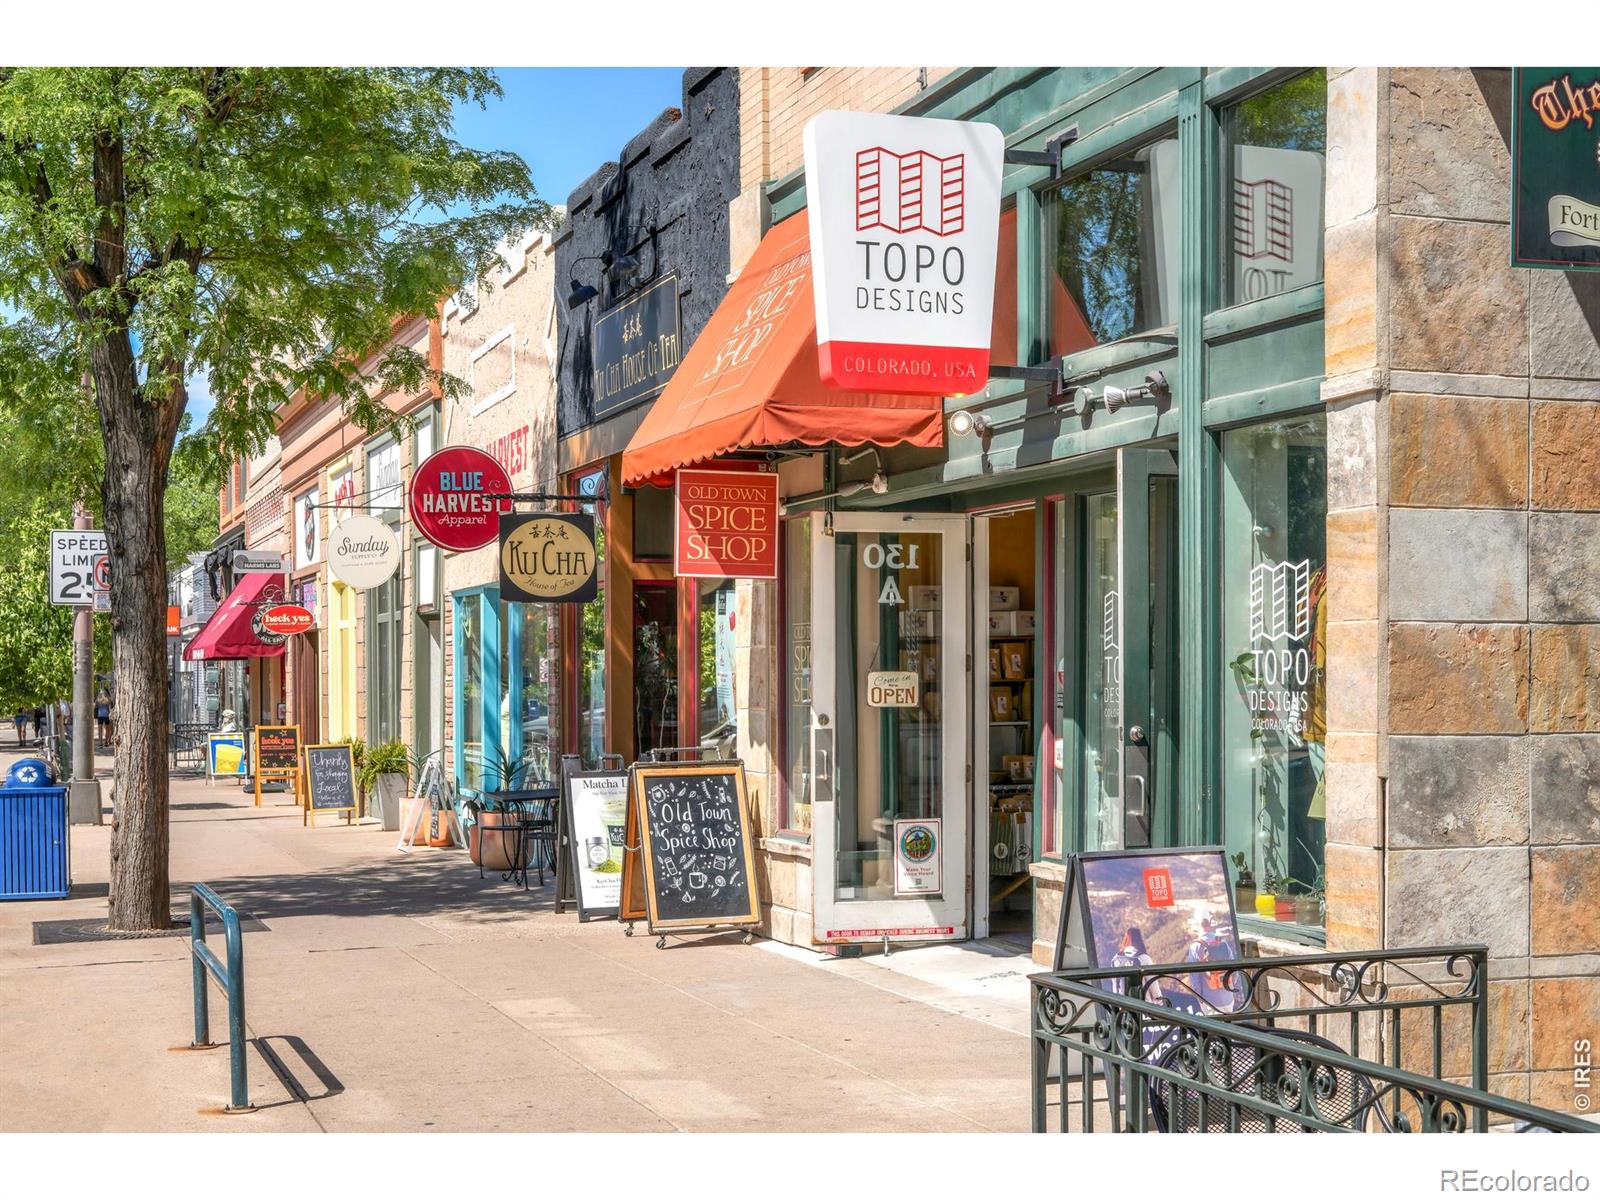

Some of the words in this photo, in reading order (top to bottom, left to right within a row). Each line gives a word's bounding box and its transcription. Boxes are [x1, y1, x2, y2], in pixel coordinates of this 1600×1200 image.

[1560, 205, 1599, 230] Fort
[856, 240, 964, 286] TOPO
[733, 273, 806, 333] SPICE
[856, 286, 964, 315] DESIGNS
[622, 350, 647, 389] HOUSE
[648, 341, 658, 377] OF
[659, 334, 679, 371] TEA
[703, 323, 773, 380] SHOP
[844, 356, 937, 378] COLORADO,
[944, 361, 976, 378] USA
[440, 471, 484, 491] BLUE
[423, 493, 501, 513] HARVEST
[688, 485, 719, 500] OLD
[720, 487, 767, 501] TOWN
[438, 514, 487, 527] Apparel
[688, 504, 767, 532] SPICE
[57, 538, 108, 551] SPEED
[337, 536, 389, 557] Sunday
[687, 534, 767, 561] SHOP
[62, 554, 93, 566] LIMI
[524, 576, 549, 590] House
[550, 583, 558, 592] of
[559, 578, 575, 589] Tea
[265, 613, 290, 623] heck
[291, 614, 311, 625] yes
[1250, 648, 1309, 686] TOPO
[871, 685, 915, 704] OPEN
[1250, 690, 1308, 712] DESIGNS
[583, 779, 618, 790] Matcha
[661, 801, 693, 823] Old
[697, 801, 732, 821] Town
[660, 828, 700, 855] Spice
[702, 827, 736, 854] Shop
